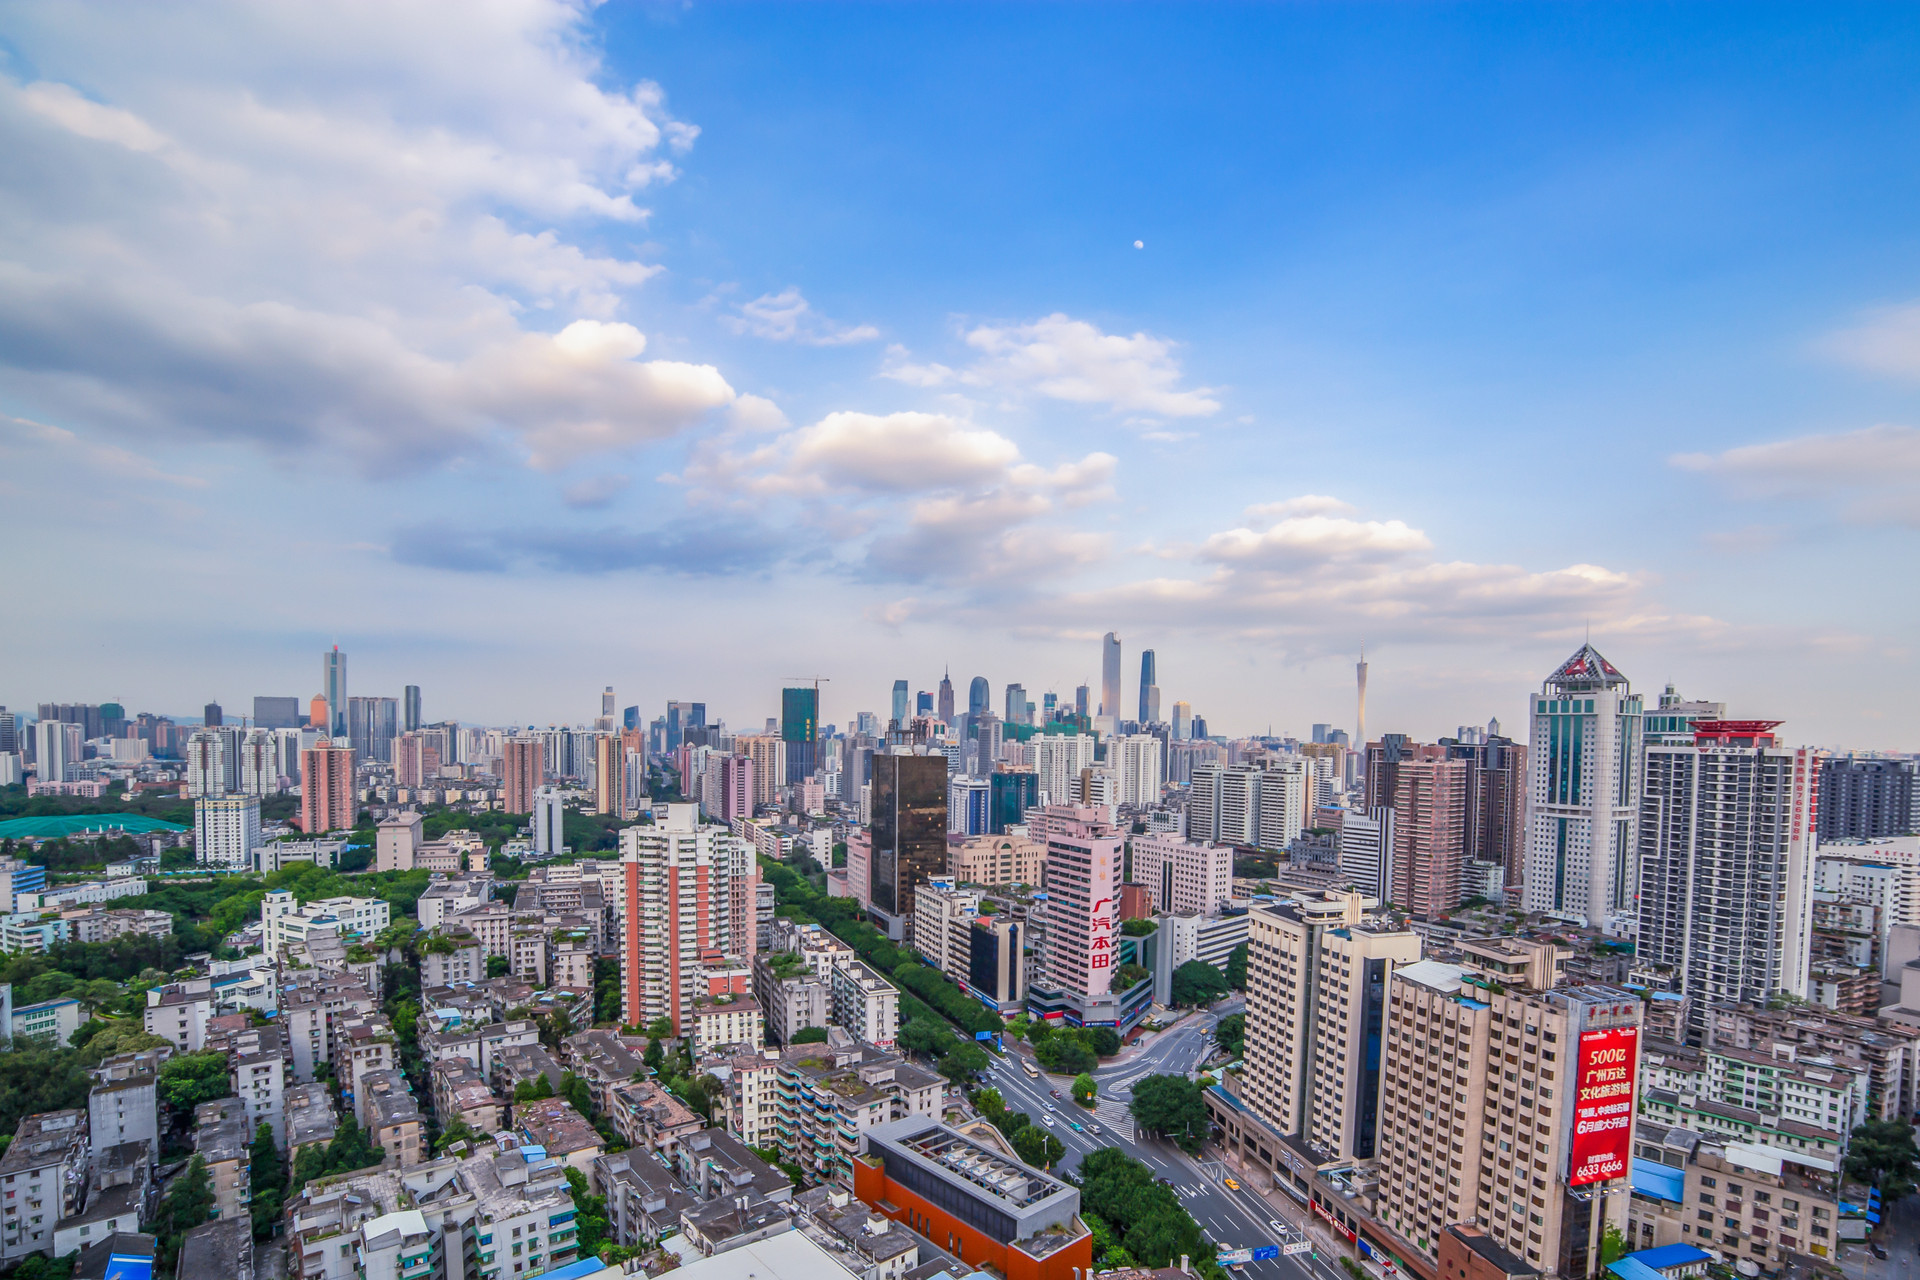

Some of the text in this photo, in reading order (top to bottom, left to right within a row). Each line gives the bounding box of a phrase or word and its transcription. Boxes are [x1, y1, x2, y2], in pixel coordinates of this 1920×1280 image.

[1091, 898, 1112, 969] 广汽本田
[1589, 1048, 1626, 1066] 500亿
[1586, 1066, 1626, 1084] 广州万达
[1580, 1082, 1631, 1101] 文化旅游城
[1577, 1116, 1629, 1135] 6月盛大开盘
[1576, 1159, 1623, 1177] 6633 6666
